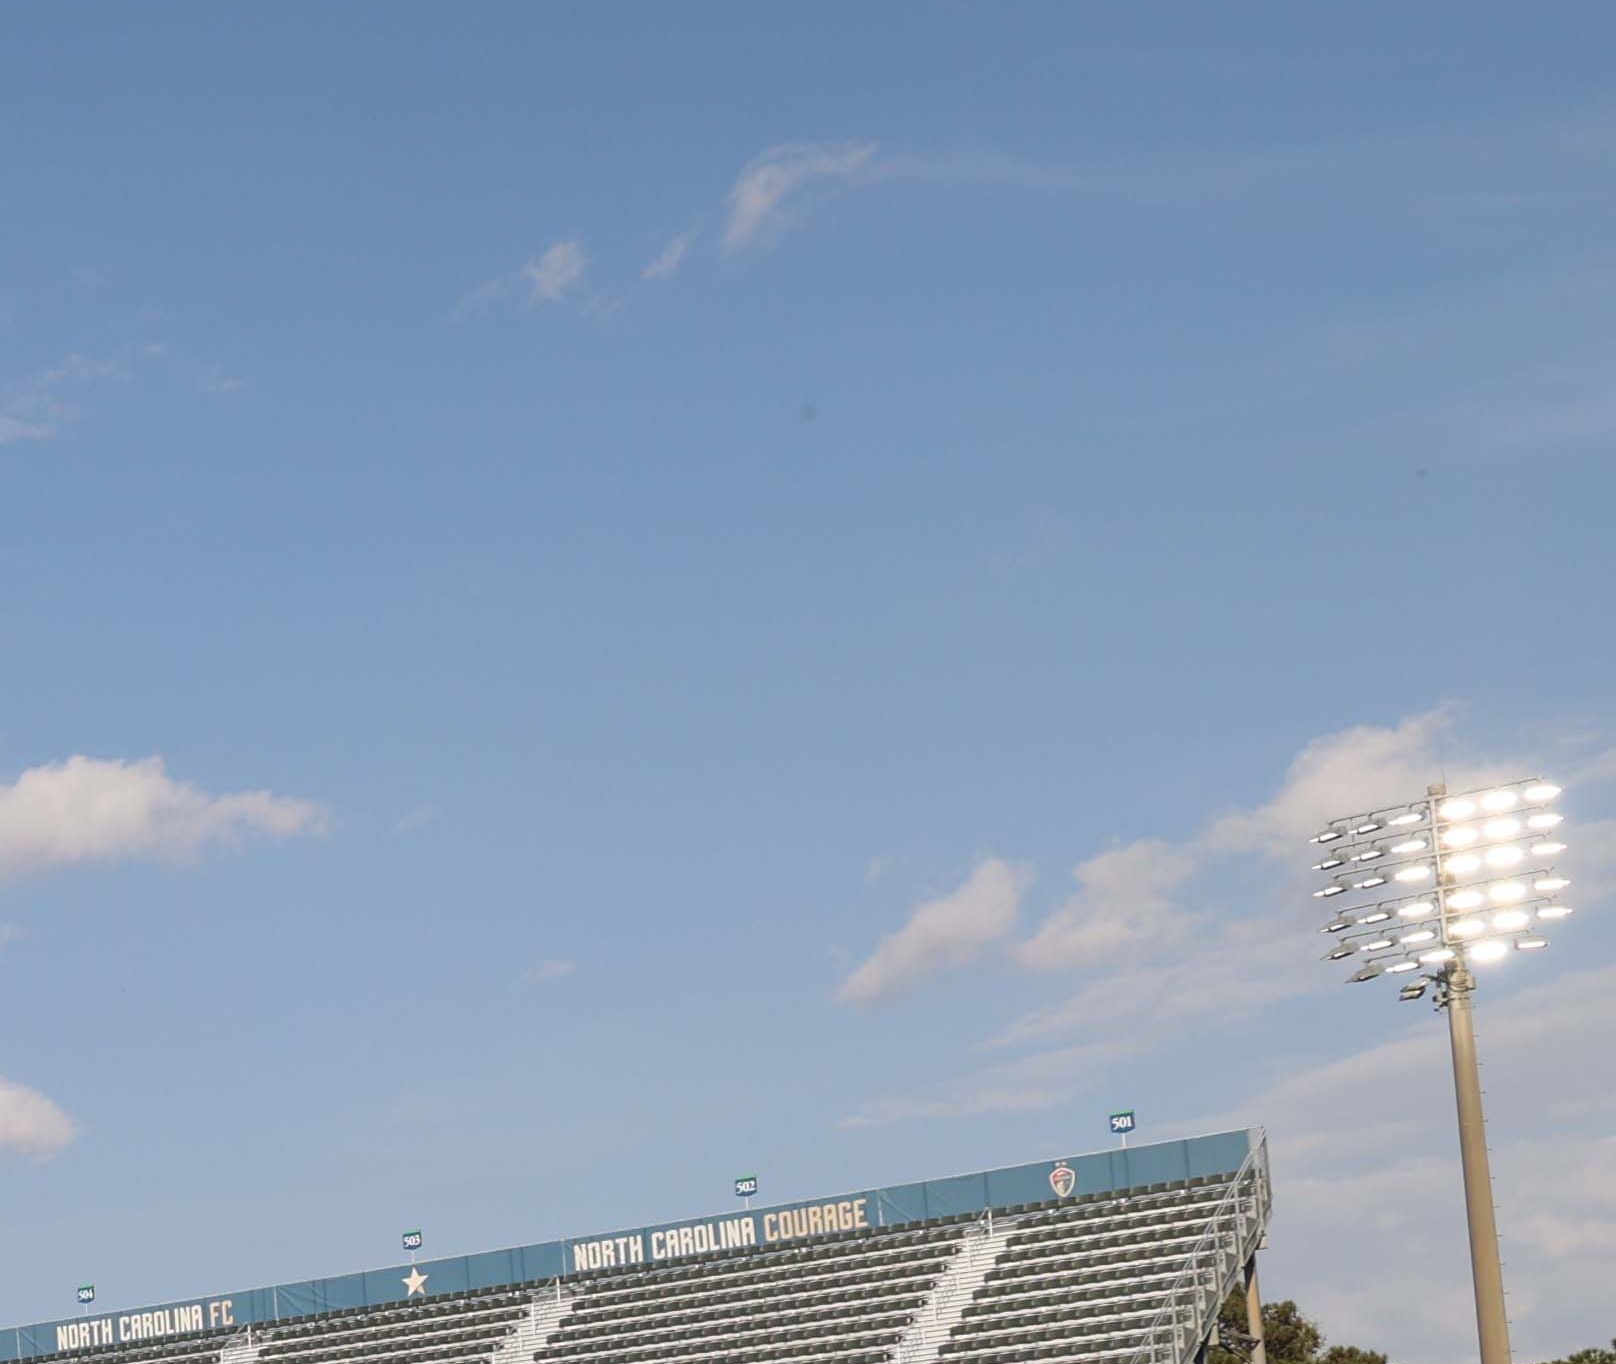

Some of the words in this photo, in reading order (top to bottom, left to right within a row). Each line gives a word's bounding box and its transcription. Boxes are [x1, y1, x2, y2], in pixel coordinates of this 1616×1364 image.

[1111, 1116, 1132, 1130] 501
[736, 1181, 757, 1193] 502
[404, 1235, 421, 1248] 503
[573, 1235, 643, 1271] NORTH
[651, 1217, 756, 1259] CAROLINA
[764, 1199, 869, 1242] COURAGE
[78, 1289, 94, 1299] 504
[56, 1318, 113, 1350] NORTH
[119, 1304, 204, 1341] CAROLINA
[209, 1300, 235, 1327] FC
